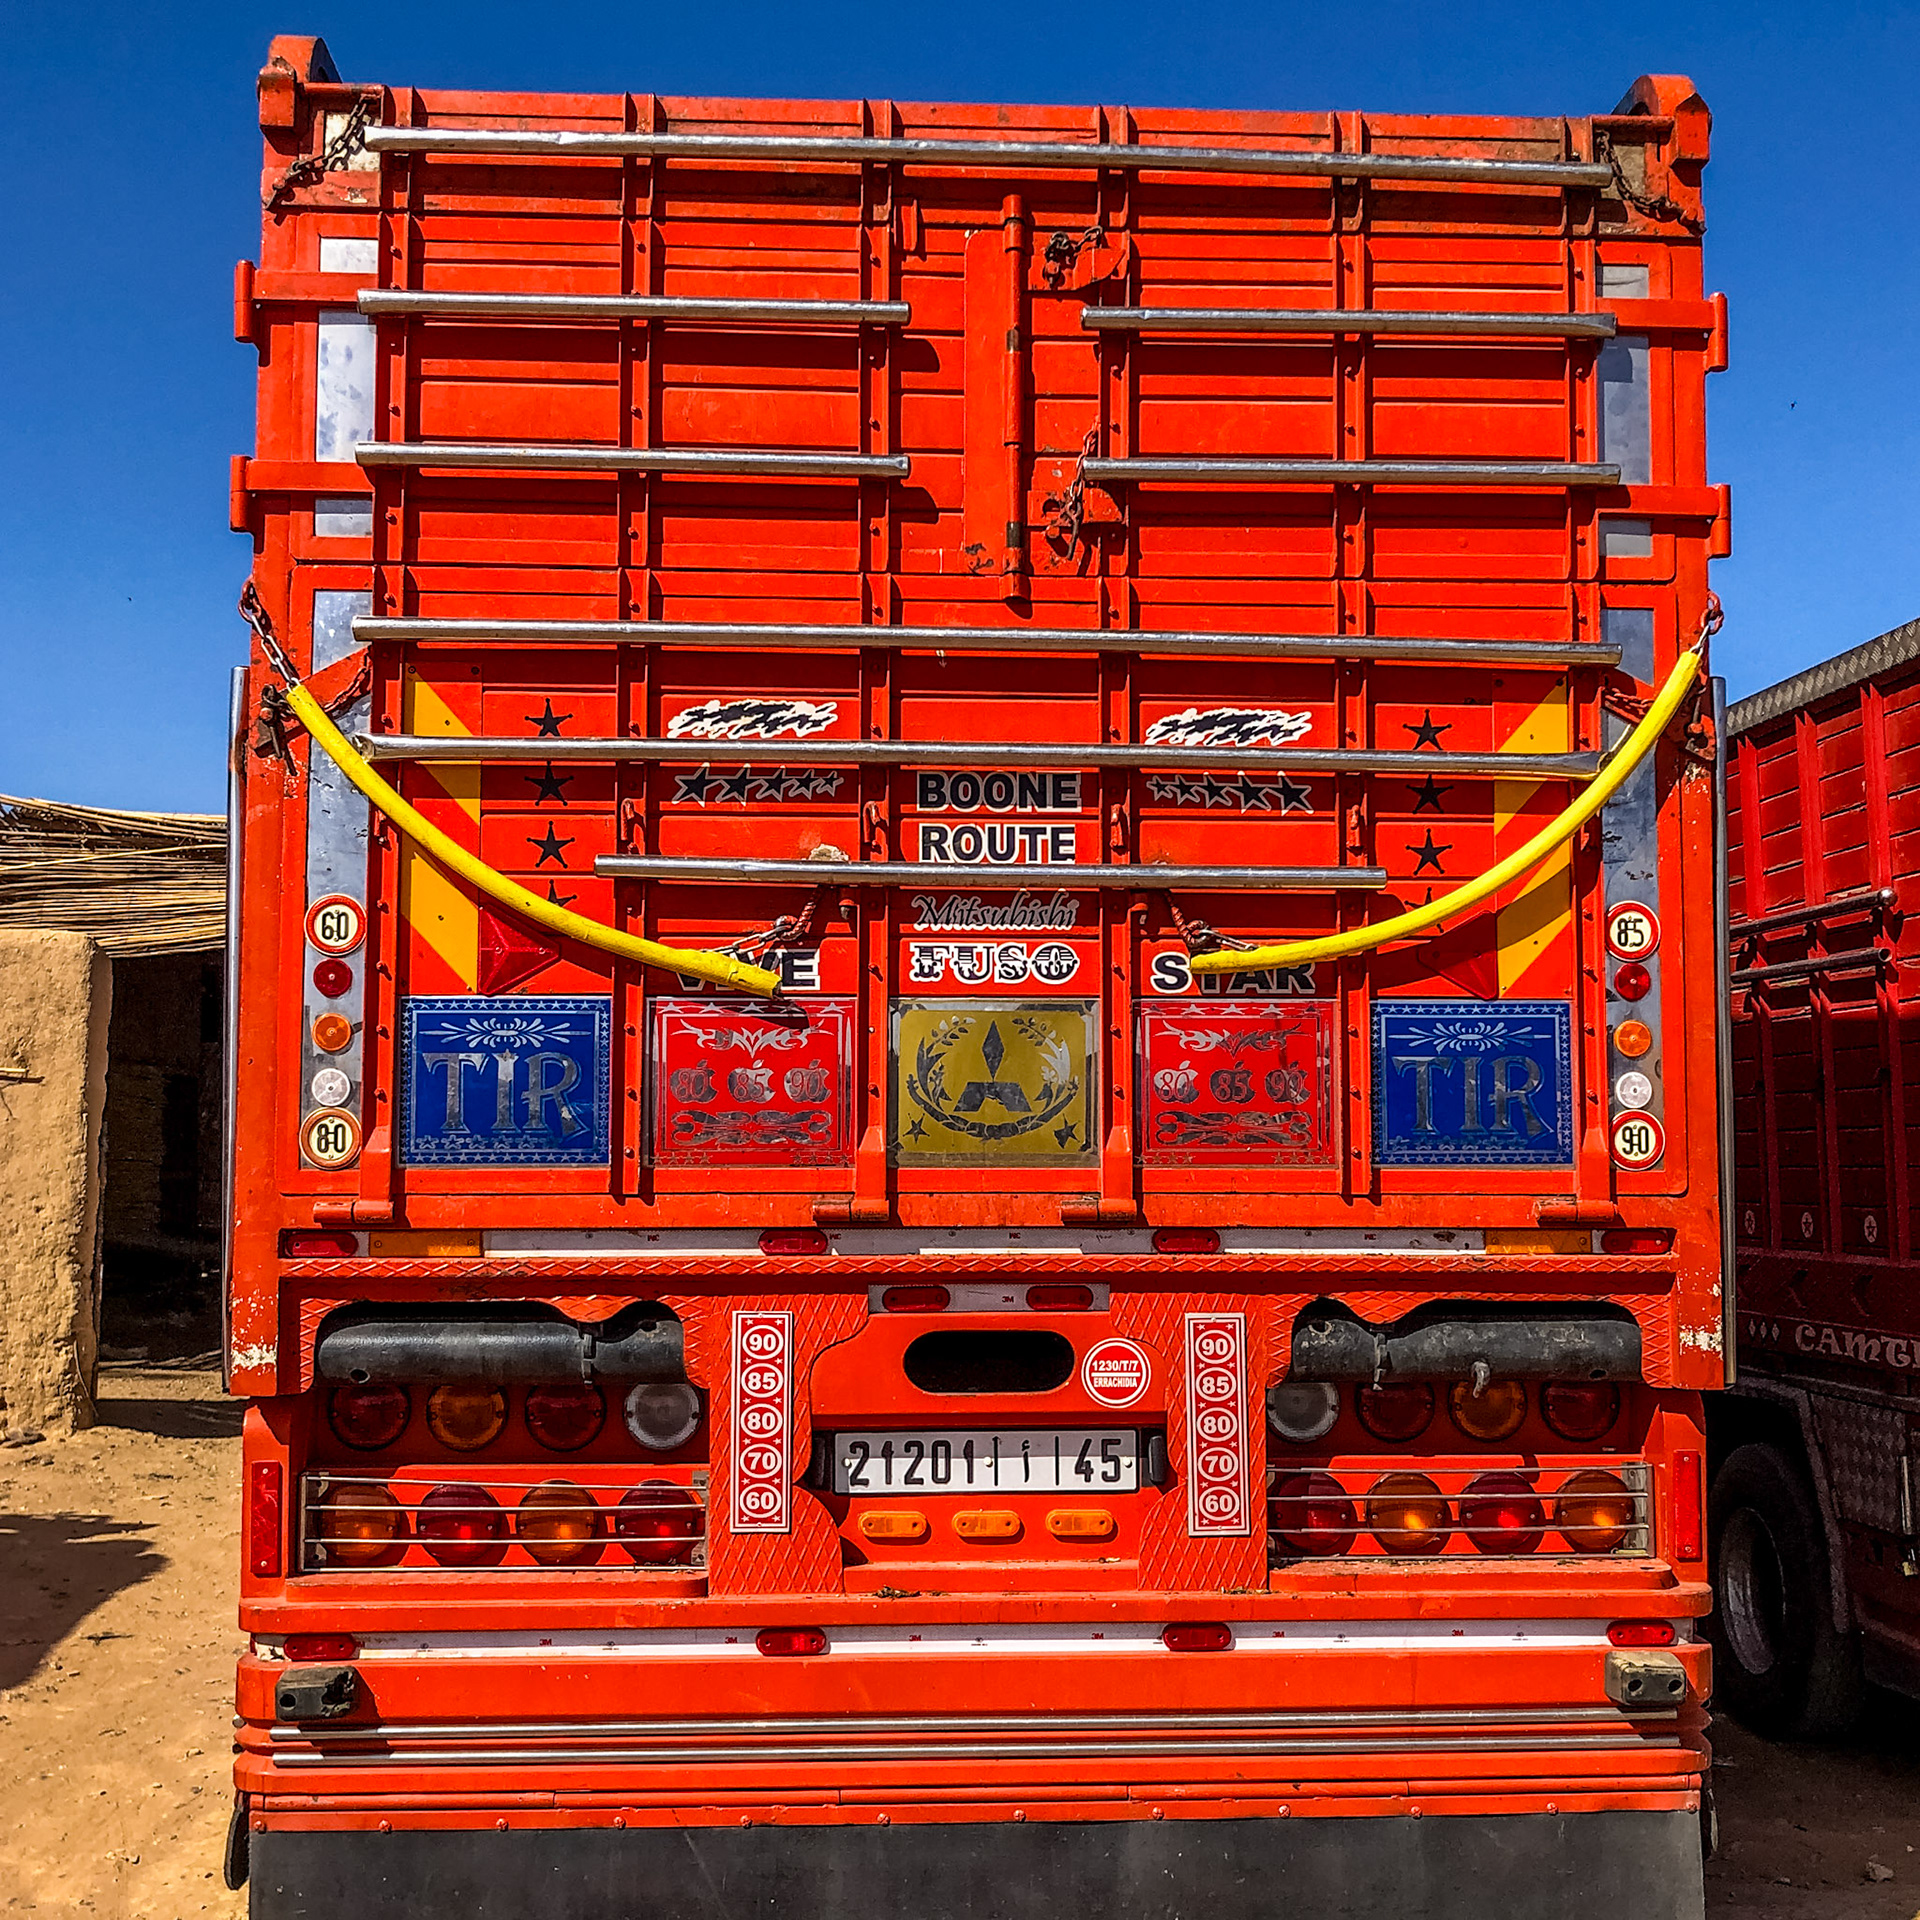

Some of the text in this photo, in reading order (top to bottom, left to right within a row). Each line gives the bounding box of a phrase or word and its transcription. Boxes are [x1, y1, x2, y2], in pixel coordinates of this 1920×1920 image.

[917, 771, 1082, 812] BOONE
[919, 823, 1076, 864] ROUTE
[911, 888, 1080, 930] Mitsubishi
[321, 911, 349, 940] 60
[1617, 918, 1644, 947] 85
[909, 942, 1080, 984] FUSO
[676, 1070, 822, 1099] 80 85 90
[1160, 1070, 1304, 1100] 80 85 90
[421, 1051, 591, 1139] TIR
[1391, 1055, 1554, 1141] TIR
[316, 1124, 346, 1153] 80
[1622, 1126, 1649, 1155] 90
[1002, 1295, 1015, 1304] 3M
[749, 1333, 777, 1352] 90
[1201, 1338, 1229, 1356] 90
[1091, 1359, 1138, 1373] 1230/T/7
[747, 1372, 776, 1391] 85
[1093, 1376, 1138, 1388] ERRACHIDIA
[1202, 1376, 1230, 1395] 85
[746, 1412, 776, 1431] 80
[1203, 1416, 1231, 1435] 80
[747, 1452, 776, 1471] 70
[849, 1440, 975, 1487] 21201
[1074, 1437, 1122, 1484] 45
[1204, 1455, 1233, 1474] 70
[745, 1491, 775, 1511] 60
[1205, 1494, 1233, 1513] 60
[539, 1638, 552, 1646] 3M
[724, 1636, 738, 1644] 3M
[1091, 1632, 1104, 1640] 3M
[1272, 1630, 1285, 1638] 3M
